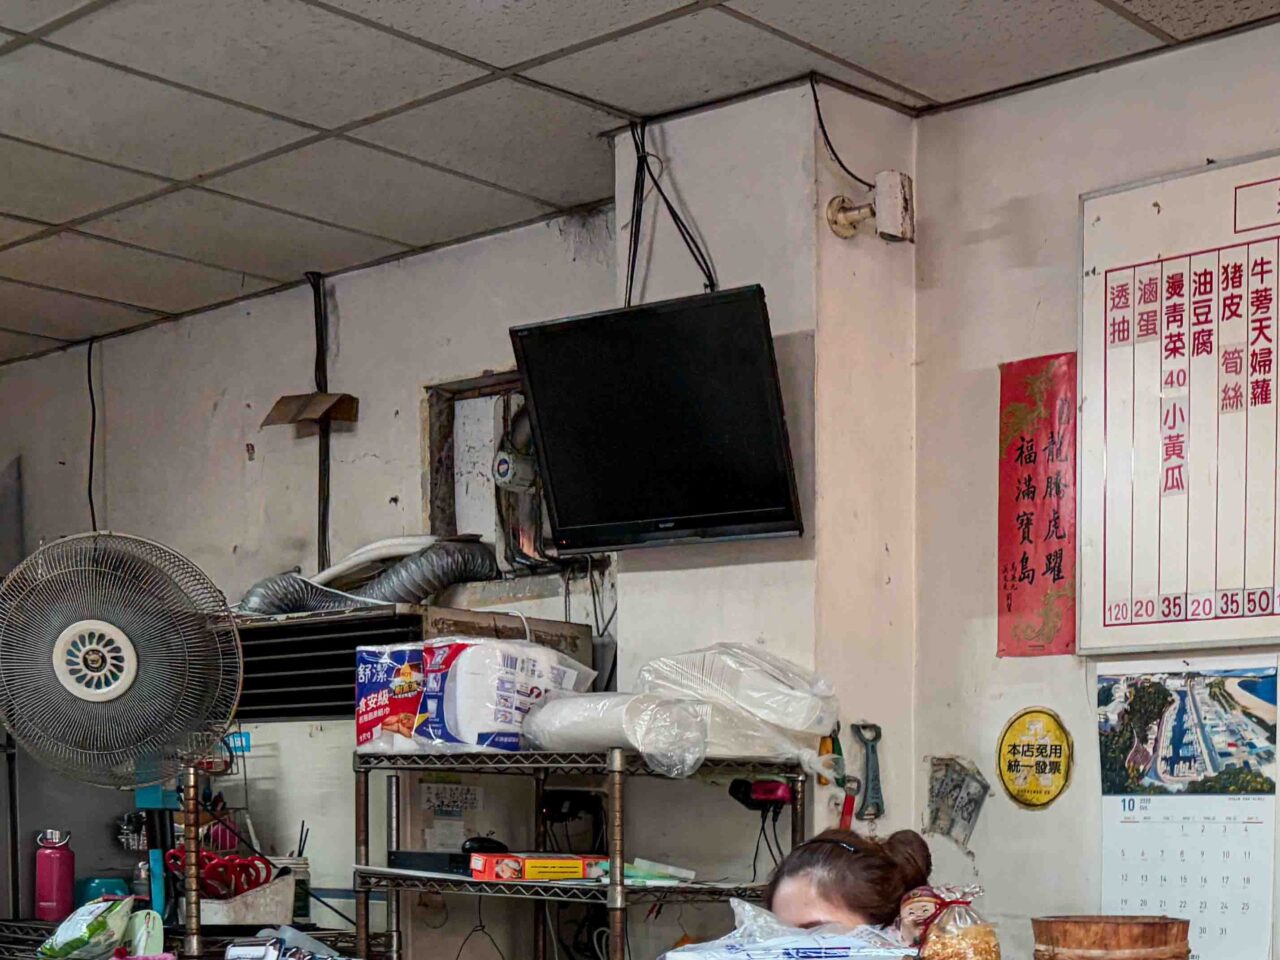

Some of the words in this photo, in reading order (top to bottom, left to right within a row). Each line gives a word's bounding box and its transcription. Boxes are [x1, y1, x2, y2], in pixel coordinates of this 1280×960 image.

[1110, 283, 1130, 344] 透抽
[1137, 278, 1158, 338] 滷蛋
[1165, 272, 1186, 360] 燙青菜
[1192, 269, 1214, 357] 油豆腐
[1164, 369, 1187, 387] 40
[1221, 348, 1243, 411] 筍絲
[1163, 402, 1185, 492] 小黃瓜
[1014, 434, 1036, 586] 福滿寶島
[1107, 602, 1128, 621] 120
[1134, 599, 1155, 618] 20
[1161, 596, 1182, 617] 35
[1191, 598, 1212, 616] 20
[1220, 592, 1240, 614] 35
[1247, 590, 1270, 613] 50
[1008, 743, 1062, 758] 本店免用
[1007, 760, 1062, 774] 統一發票
[1121, 798, 1135, 812] 10
